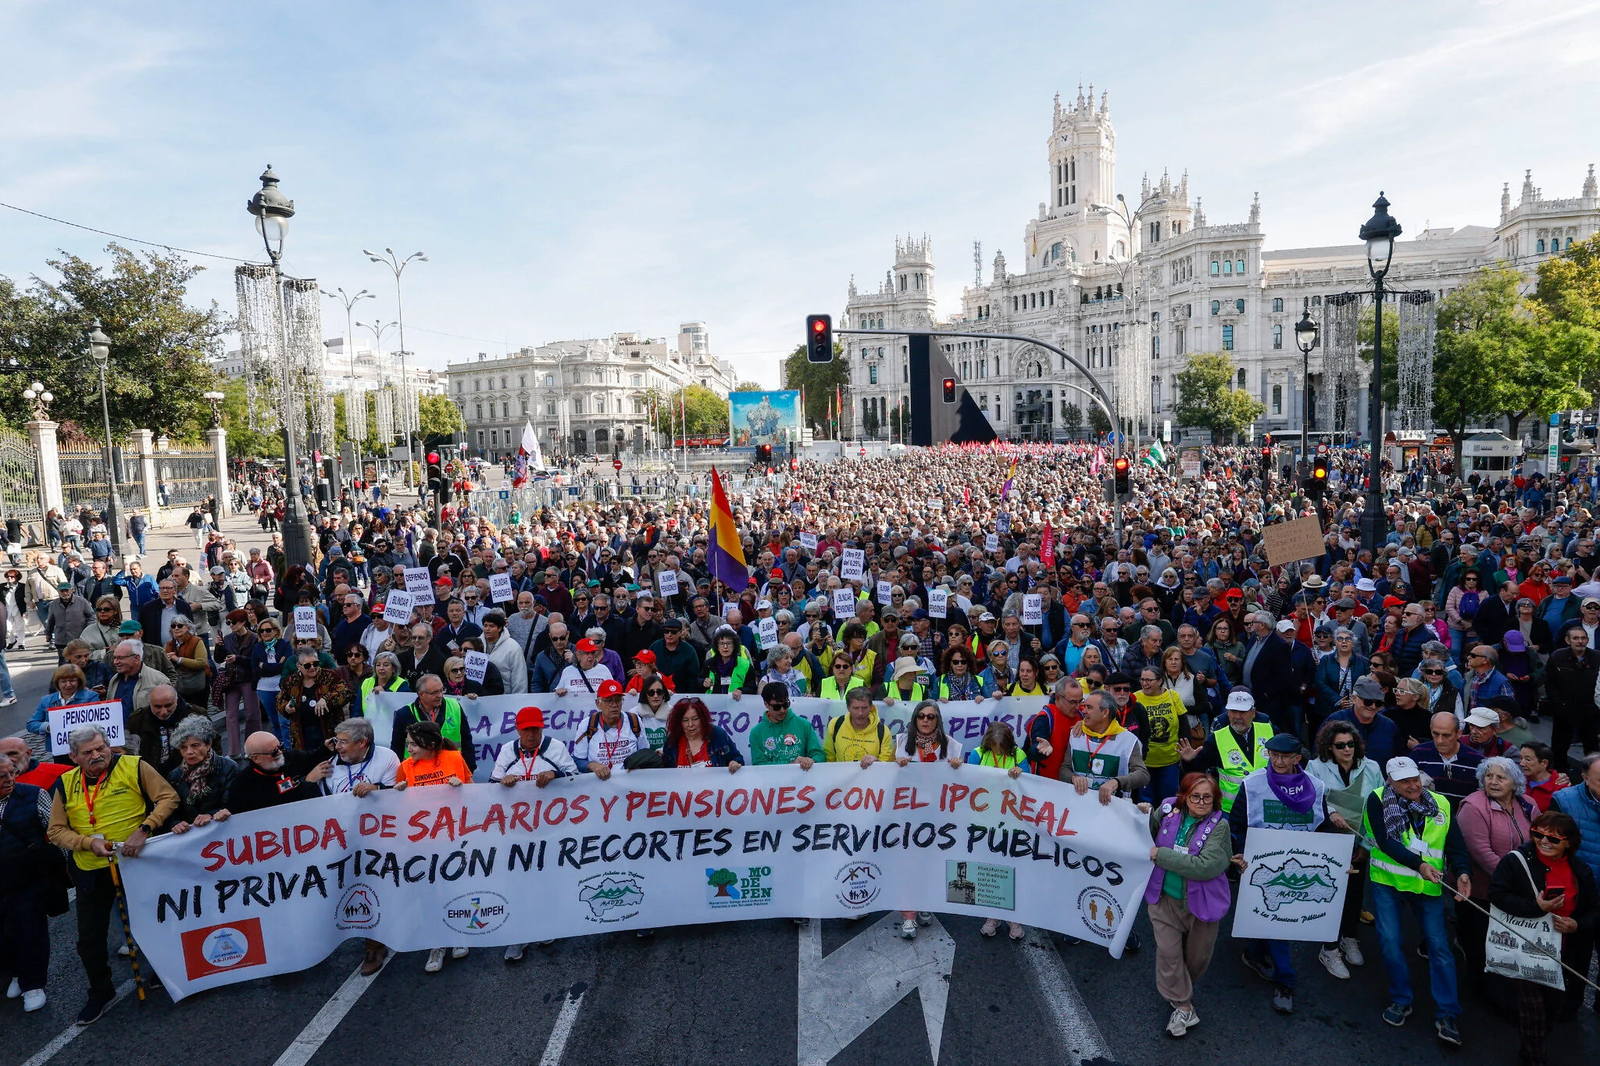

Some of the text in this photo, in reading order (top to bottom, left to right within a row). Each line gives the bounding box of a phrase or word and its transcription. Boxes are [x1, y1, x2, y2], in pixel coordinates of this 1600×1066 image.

[405, 572, 428, 582] DEFIENDO
[409, 583, 429, 593] también
[63, 707, 110, 728] ¡PENSIONES
[500, 709, 599, 734] BECH
[414, 770, 444, 781] SINDICATO
[201, 783, 1078, 872] SUBIDA DE SALARIOS Y PENSIONES CON EL IPC REAL
[157, 885, 202, 923] NI
[214, 841, 497, 914] PRIVATIZACIÓN
[508, 840, 547, 872] NI
[558, 828, 733, 870] RECORTES
[742, 829, 783, 854] EN
[792, 822, 957, 856] SERVICIOS
[966, 822, 1124, 886] PÚBLICOS
[749, 866, 771, 877] MO
[741, 877, 760, 888] DE
[741, 887, 772, 899] PEN
[447, 905, 504, 919] EHPM MPEH
[1271, 913, 1299, 923] Pensiones
[1502, 914, 1539, 930] Madrid
